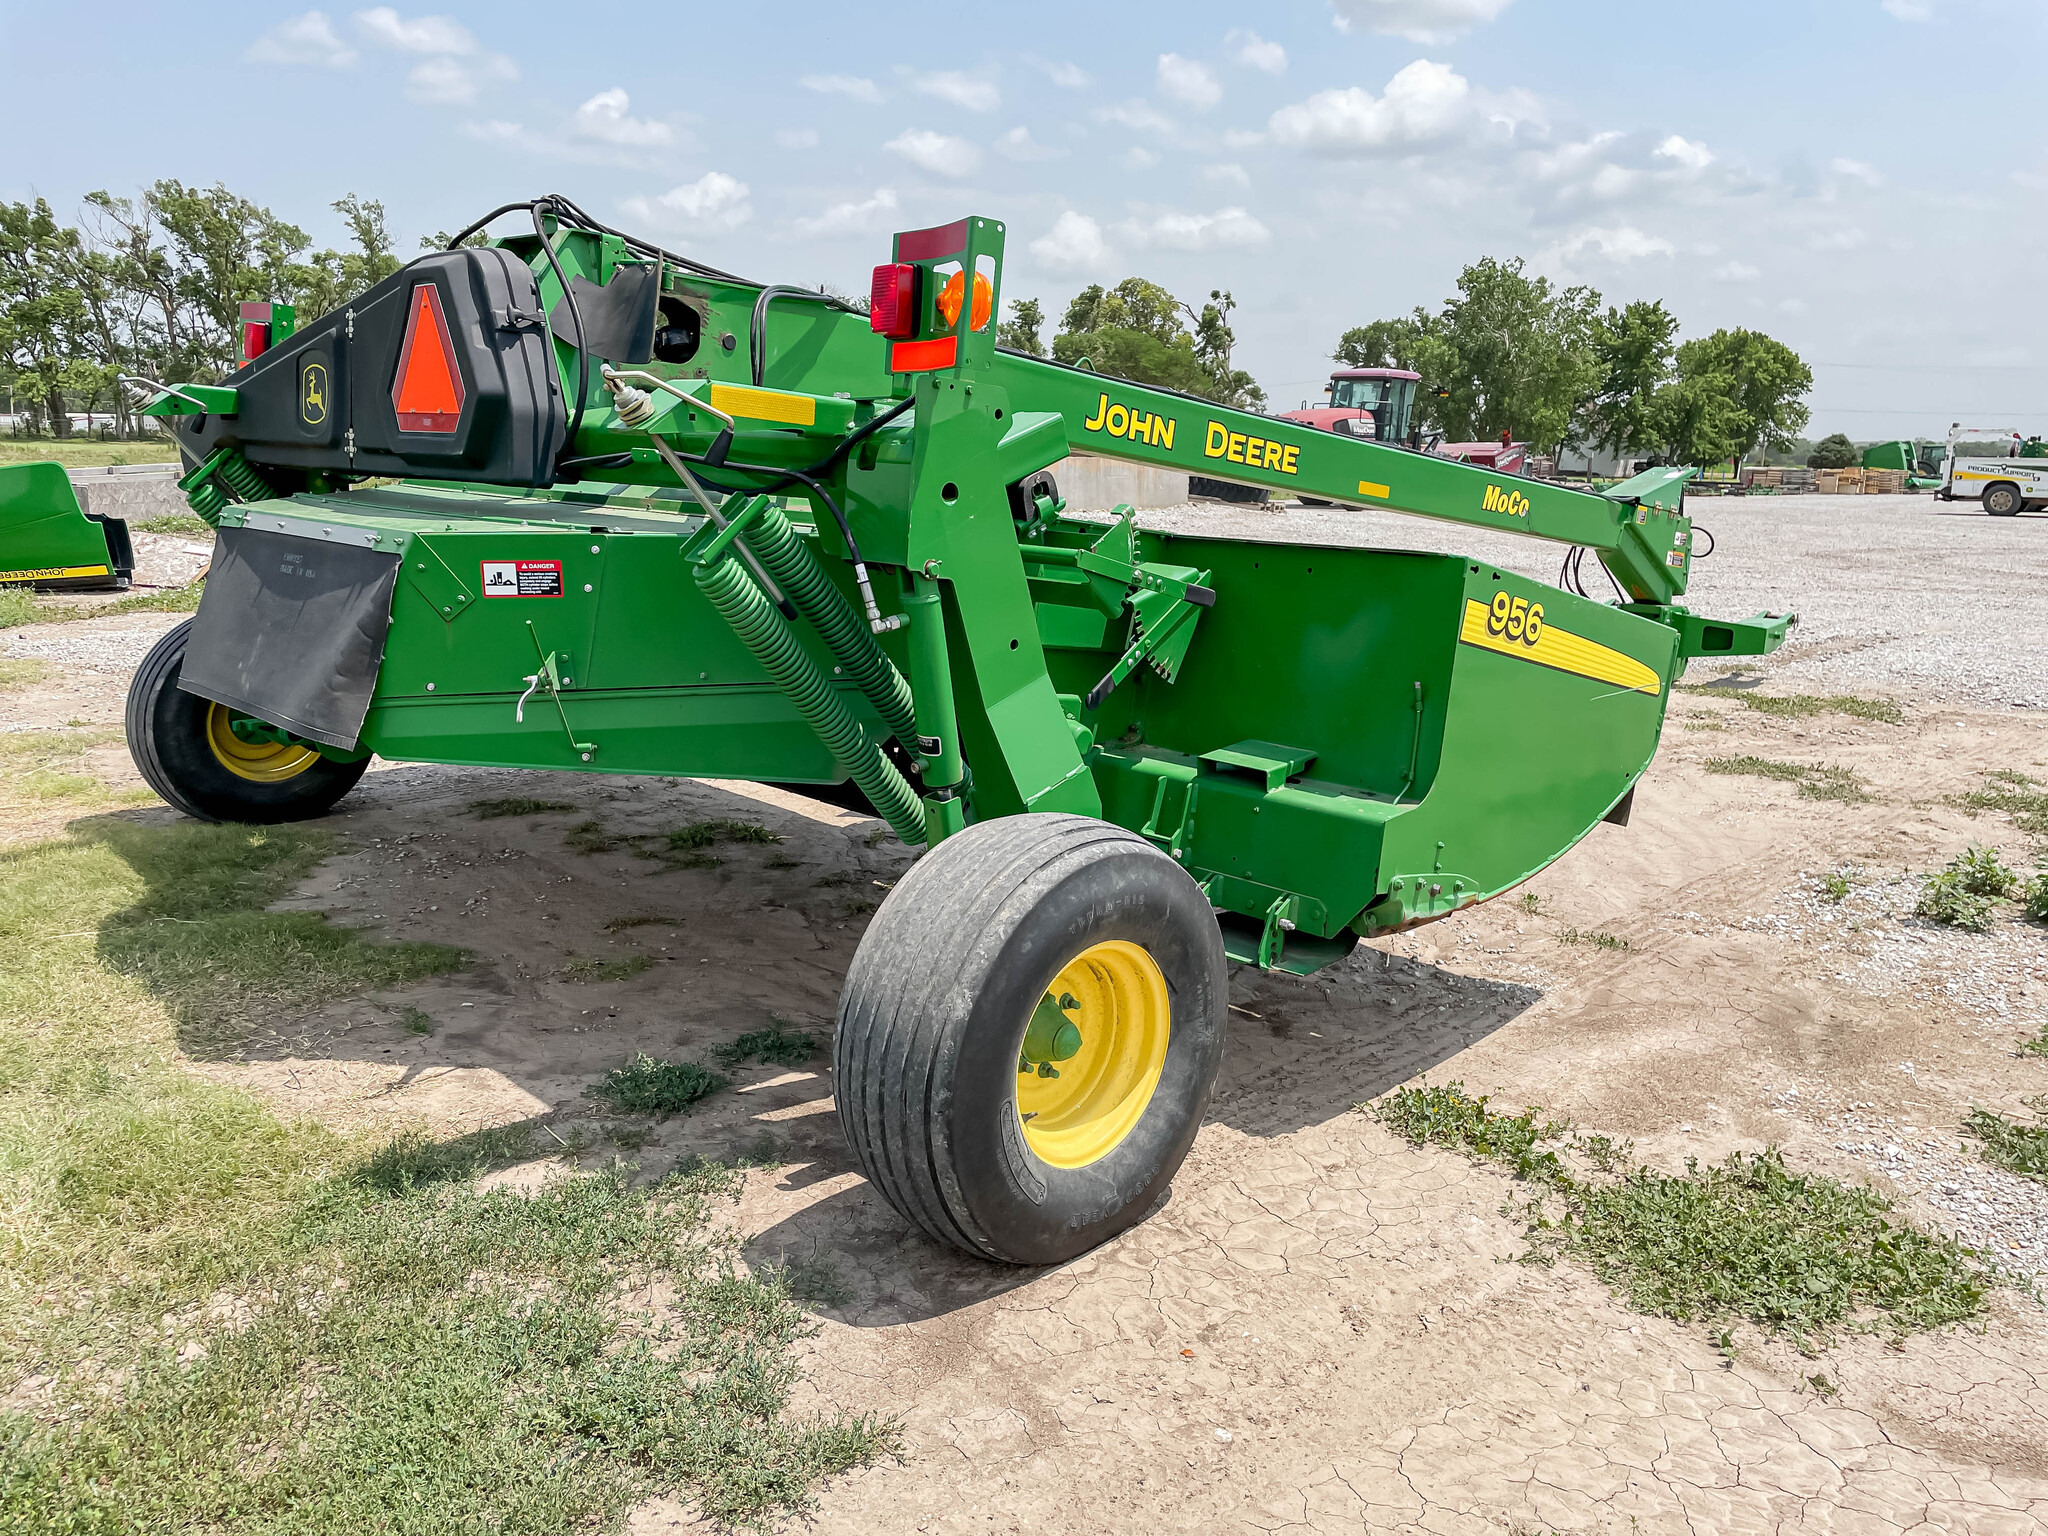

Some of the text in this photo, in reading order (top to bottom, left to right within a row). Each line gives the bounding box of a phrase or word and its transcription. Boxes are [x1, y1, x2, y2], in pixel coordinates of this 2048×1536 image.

[1084, 392, 1300, 475] JOHN DEERE
[1353, 426, 1375, 434] MacDon
[1967, 465, 2036, 478] PRODUCT SUPPORT
[1481, 484, 1530, 517] MoCo
[35, 568, 67, 577] JOHN
[1488, 590, 1545, 646] 956
